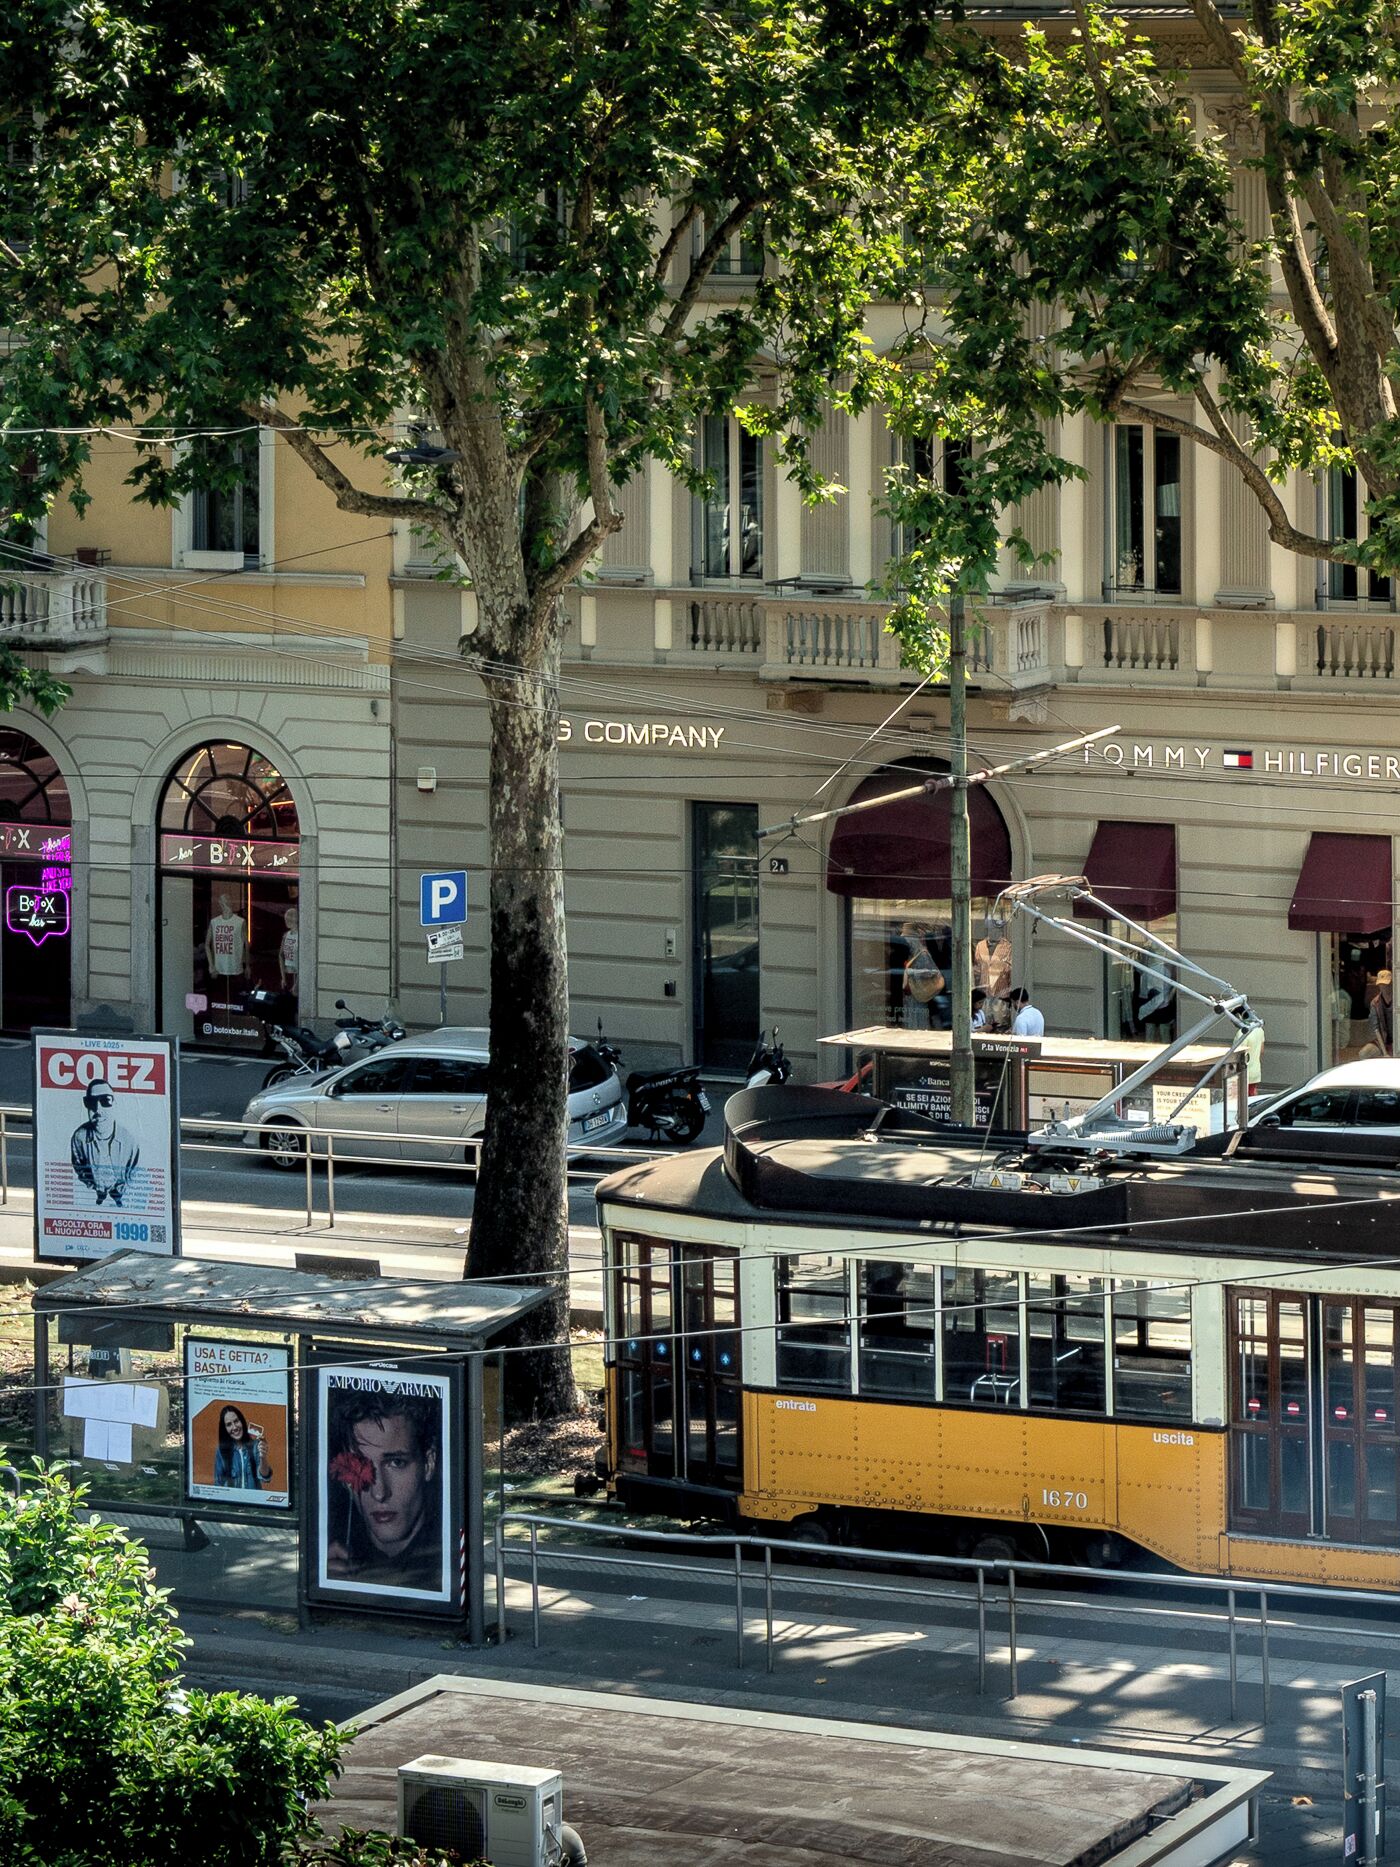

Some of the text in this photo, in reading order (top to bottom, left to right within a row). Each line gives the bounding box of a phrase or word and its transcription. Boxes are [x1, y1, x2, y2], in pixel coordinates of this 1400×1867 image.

[584, 721, 725, 749] COMPANY
[1083, 742, 1211, 769] TOMMY
[431, 879, 458, 918] P
[215, 925, 234, 934] STOP
[215, 934, 234, 942] BEING
[215, 942, 233, 955] FAKE
[85, 1040, 101, 1048] LIVE
[981, 1043, 994, 1051] P.ta
[995, 1044, 1020, 1053] Venezia
[48, 1052, 156, 1091] COEZ
[927, 1077, 950, 1086] Banca
[905, 1093, 916, 1101] SE
[916, 1094, 929, 1103] SEI
[896, 1101, 930, 1111] ILLIMITY
[52, 1219, 104, 1230] ASCOLTA ORA
[46, 1226, 111, 1238] IL NUOVO ALBUM
[114, 1222, 148, 1242] 1998
[195, 1346, 269, 1364] USA E GETTA?
[194, 1361, 231, 1373] BASTA!
[327, 1374, 444, 1399] EMPORIO ARMANI
[775, 1398, 817, 1412] entrata
[1152, 1430, 1195, 1446] uscita
[1041, 1488, 1088, 1510] 1670
